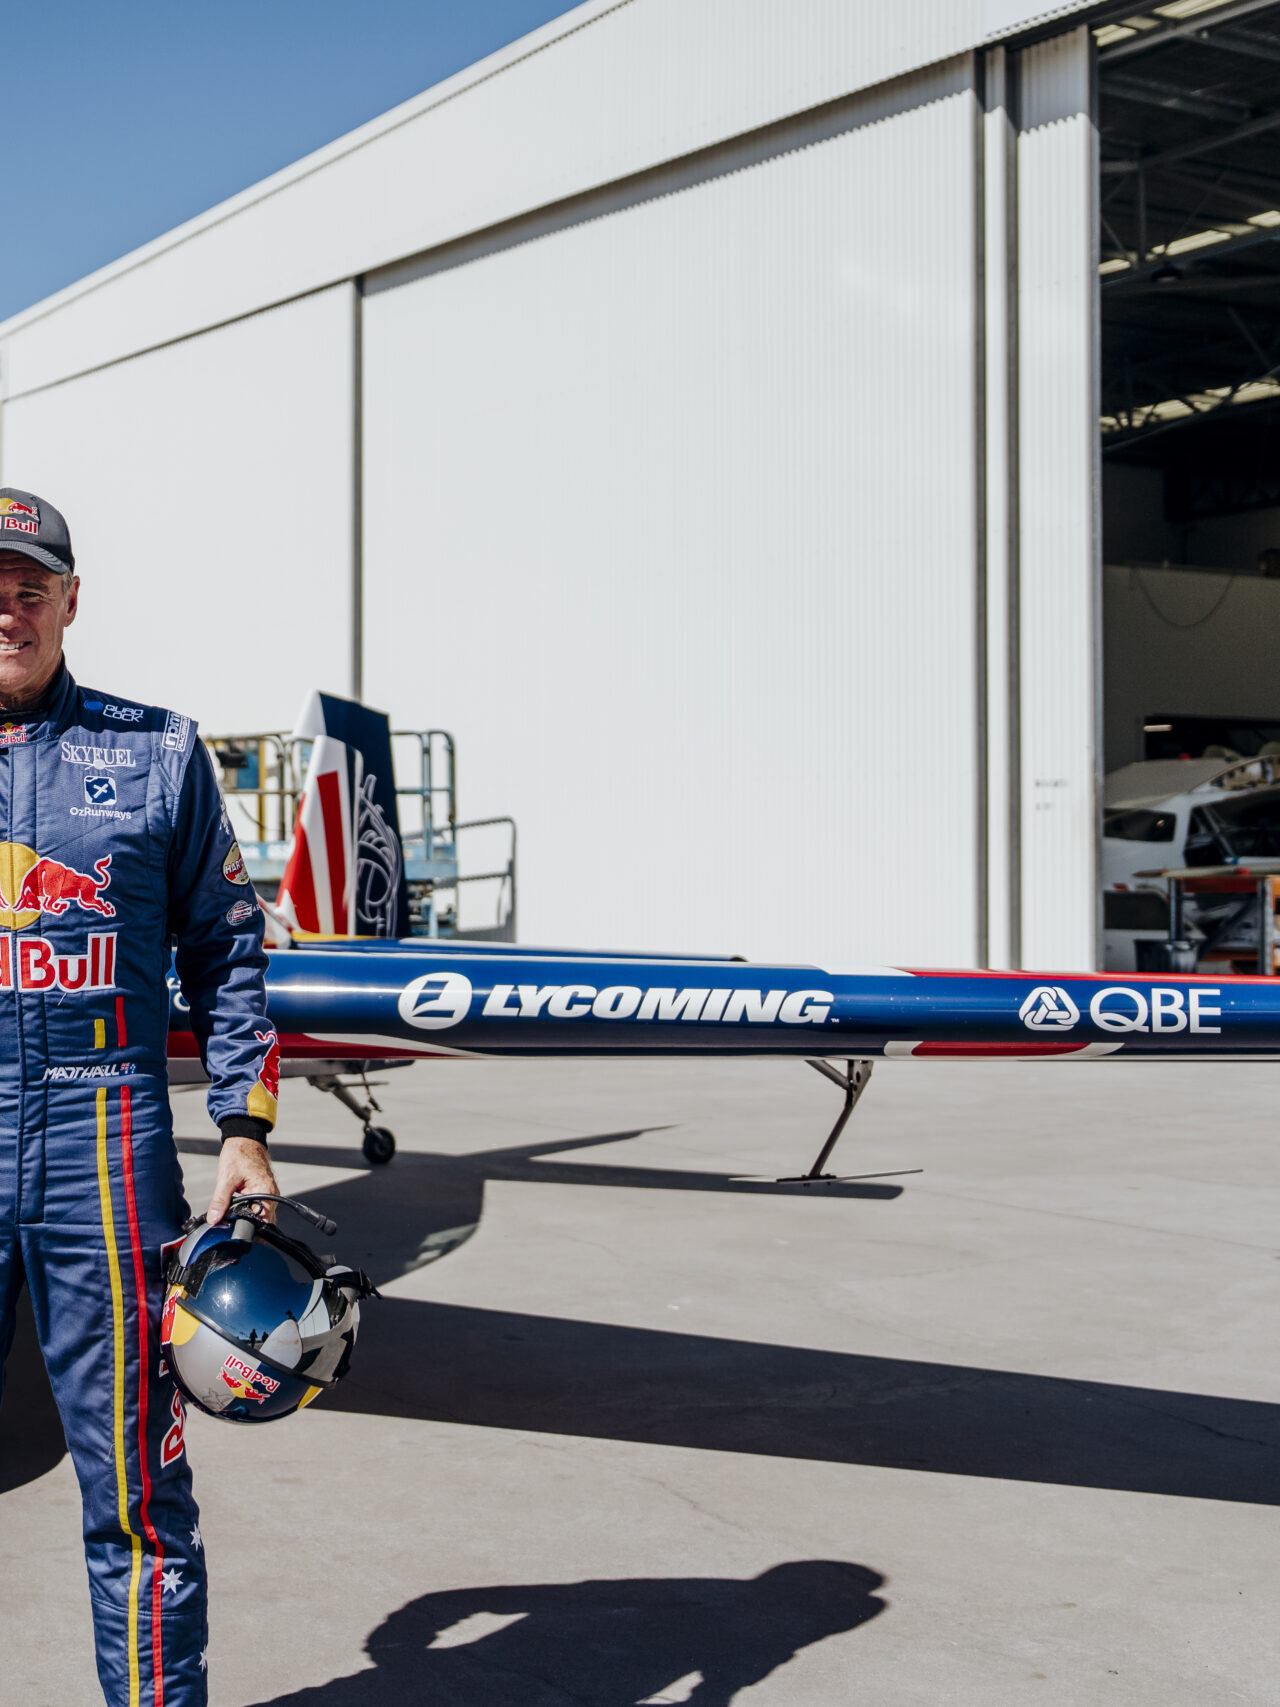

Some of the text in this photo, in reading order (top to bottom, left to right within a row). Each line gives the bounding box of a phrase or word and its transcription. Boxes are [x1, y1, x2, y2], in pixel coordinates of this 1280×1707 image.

[4, 517, 38, 535] Bull
[102, 709, 144, 722] LOCK
[105, 704, 144, 716] QUAD
[10, 733, 26, 744] Bull
[61, 742, 136, 767] SKYFUEL
[70, 806, 132, 820] OzRunways
[17, 932, 117, 993] Bull
[482, 984, 835, 1024] LYCOMING
[1089, 986, 1221, 1033] QBE
[224, 1354, 280, 1393] Red Bull
